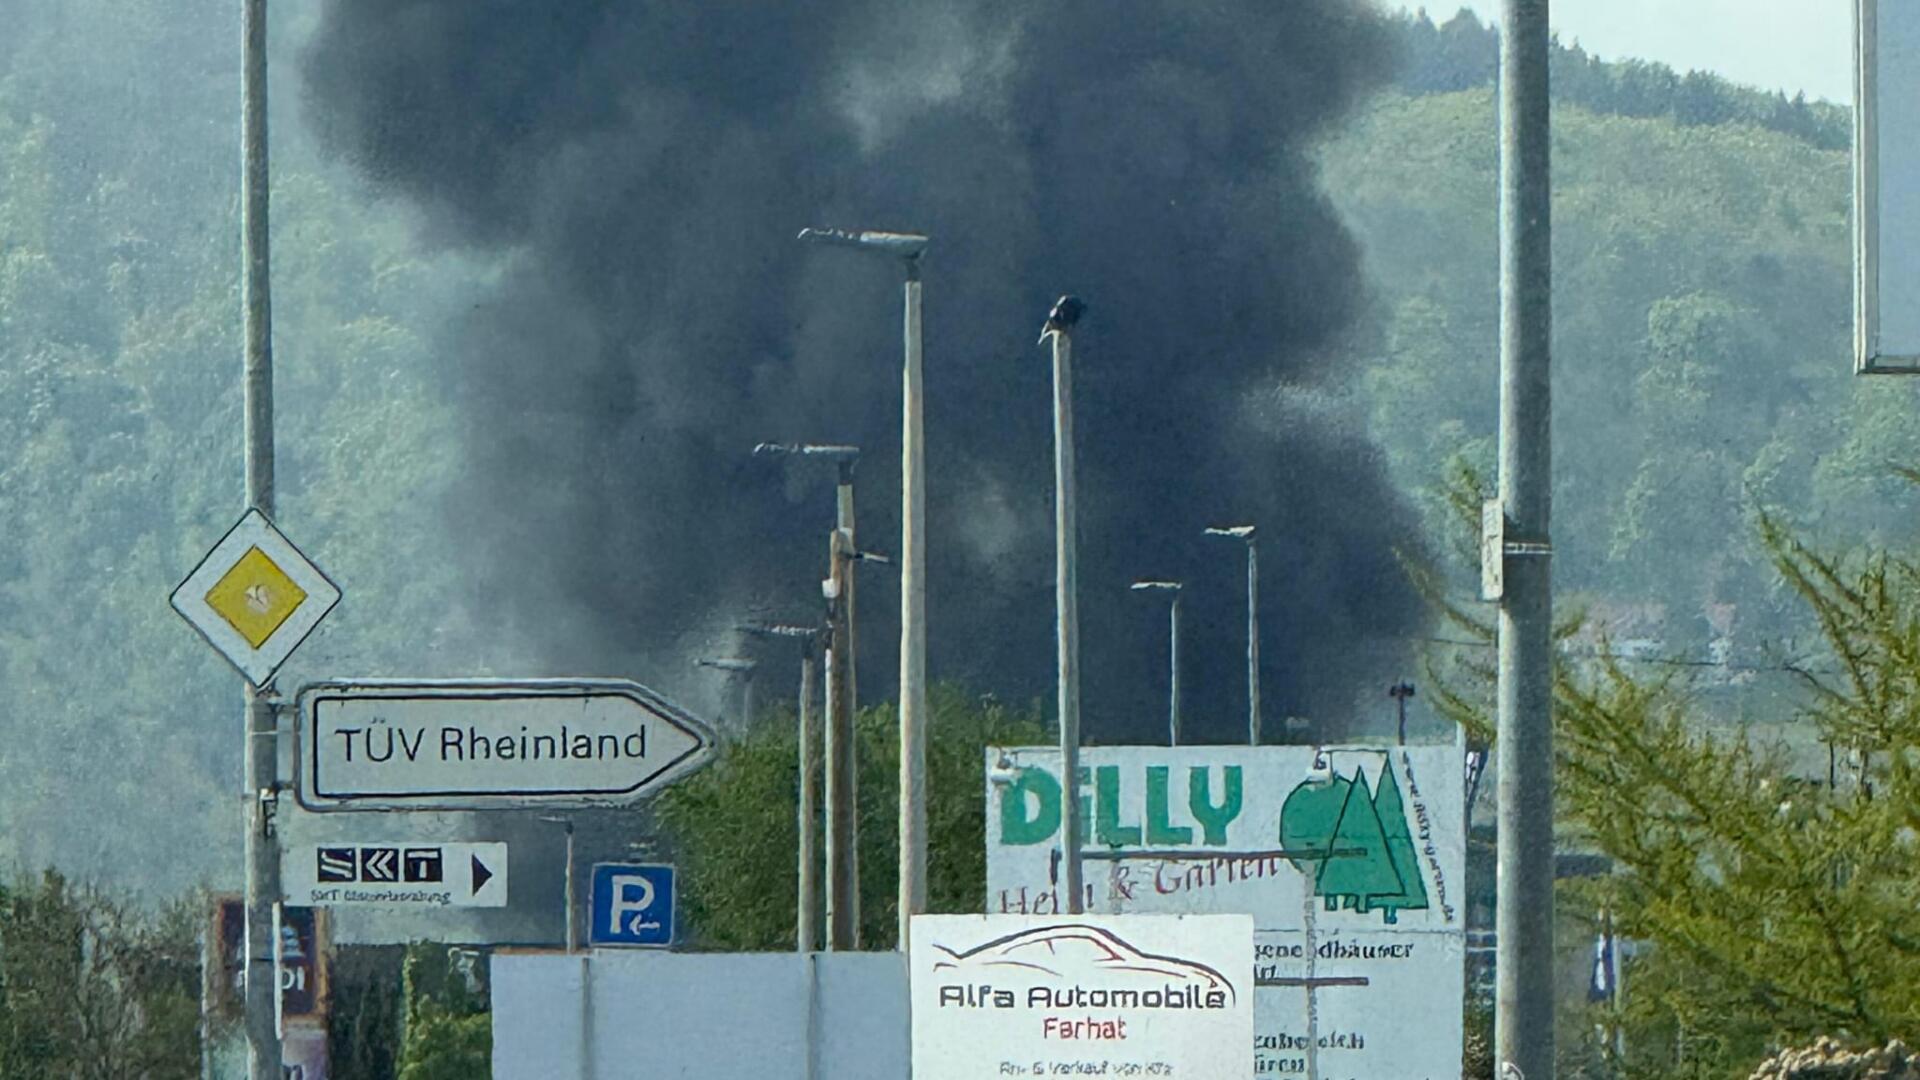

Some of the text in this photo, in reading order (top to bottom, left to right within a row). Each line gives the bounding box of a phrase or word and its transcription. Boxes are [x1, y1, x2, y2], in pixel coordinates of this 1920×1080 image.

[335, 717, 647, 762] TÜV Rheinland
[610, 875, 655, 934] P
[939, 984, 1227, 1009] Alfa Automobile
[1043, 1016, 1127, 1039] Farhat
